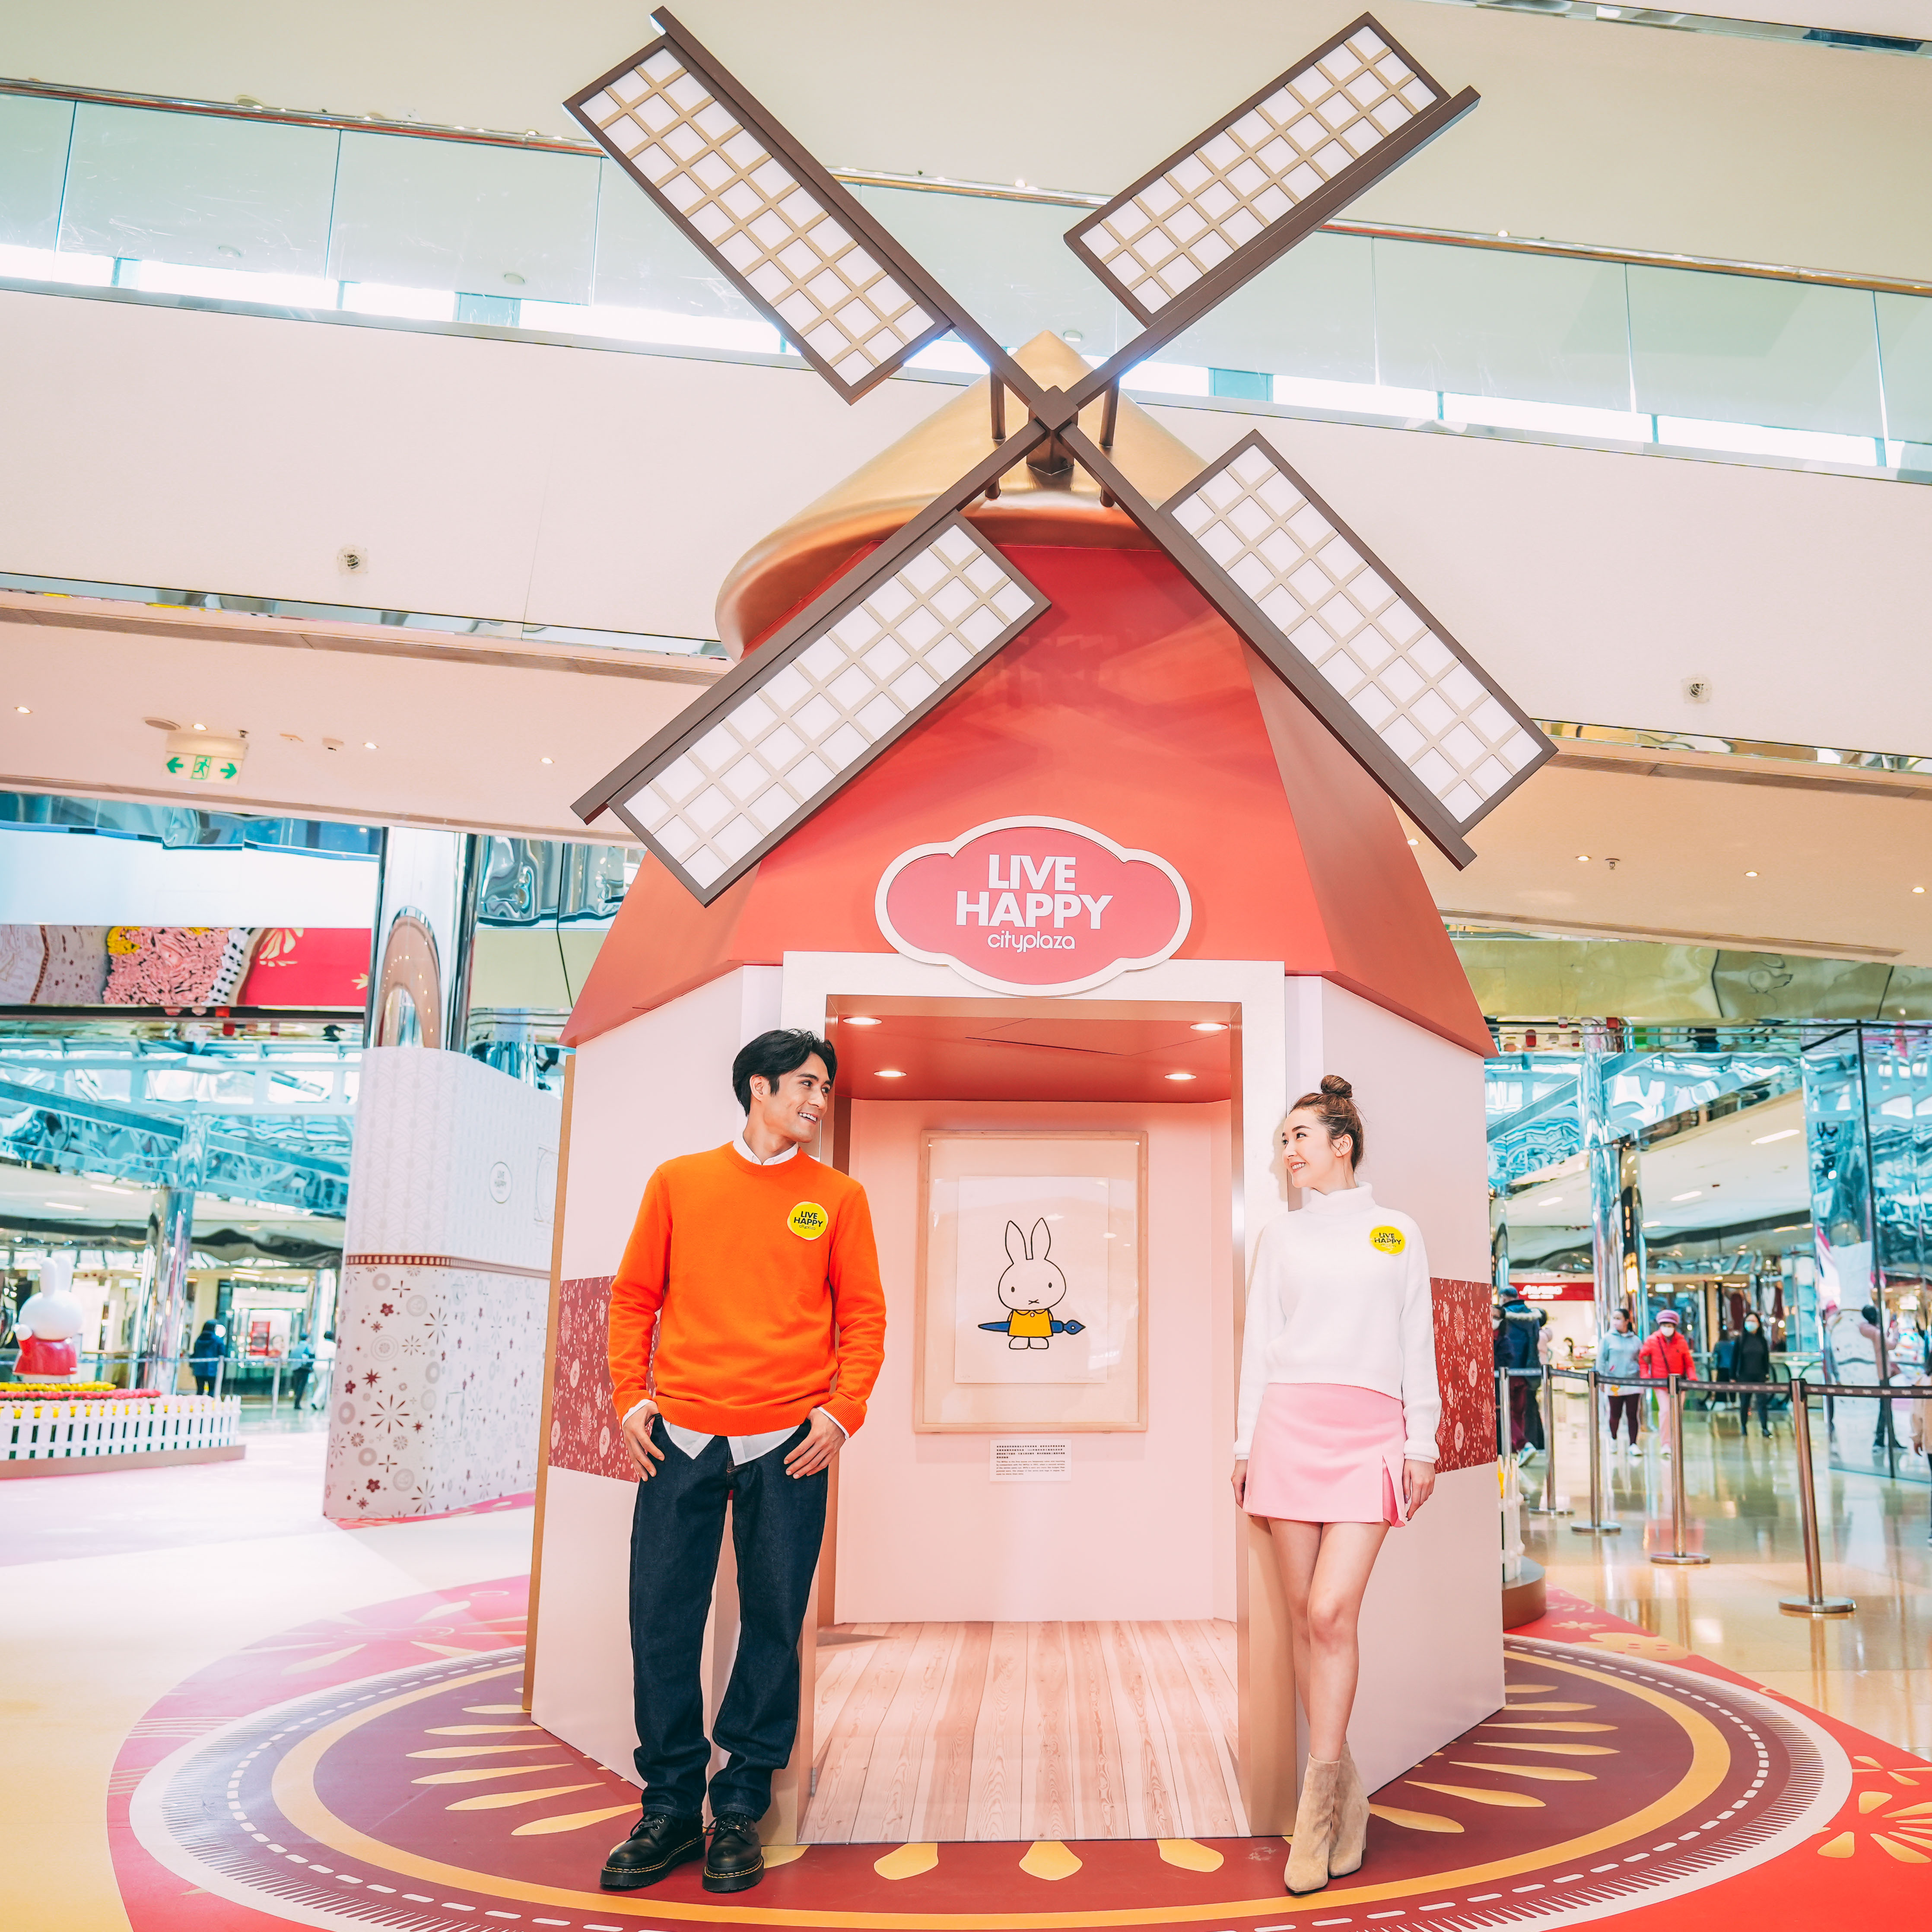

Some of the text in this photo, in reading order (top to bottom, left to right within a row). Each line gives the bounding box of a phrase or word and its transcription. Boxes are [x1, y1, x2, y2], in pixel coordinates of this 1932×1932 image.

[988, 854, 1076, 891] LIVE
[956, 891, 1113, 929] HAPPY
[987, 930, 1075, 953] cityplaza
[794, 1217, 823, 1227] HAPPY
[801, 1211, 818, 1219] LIVE
